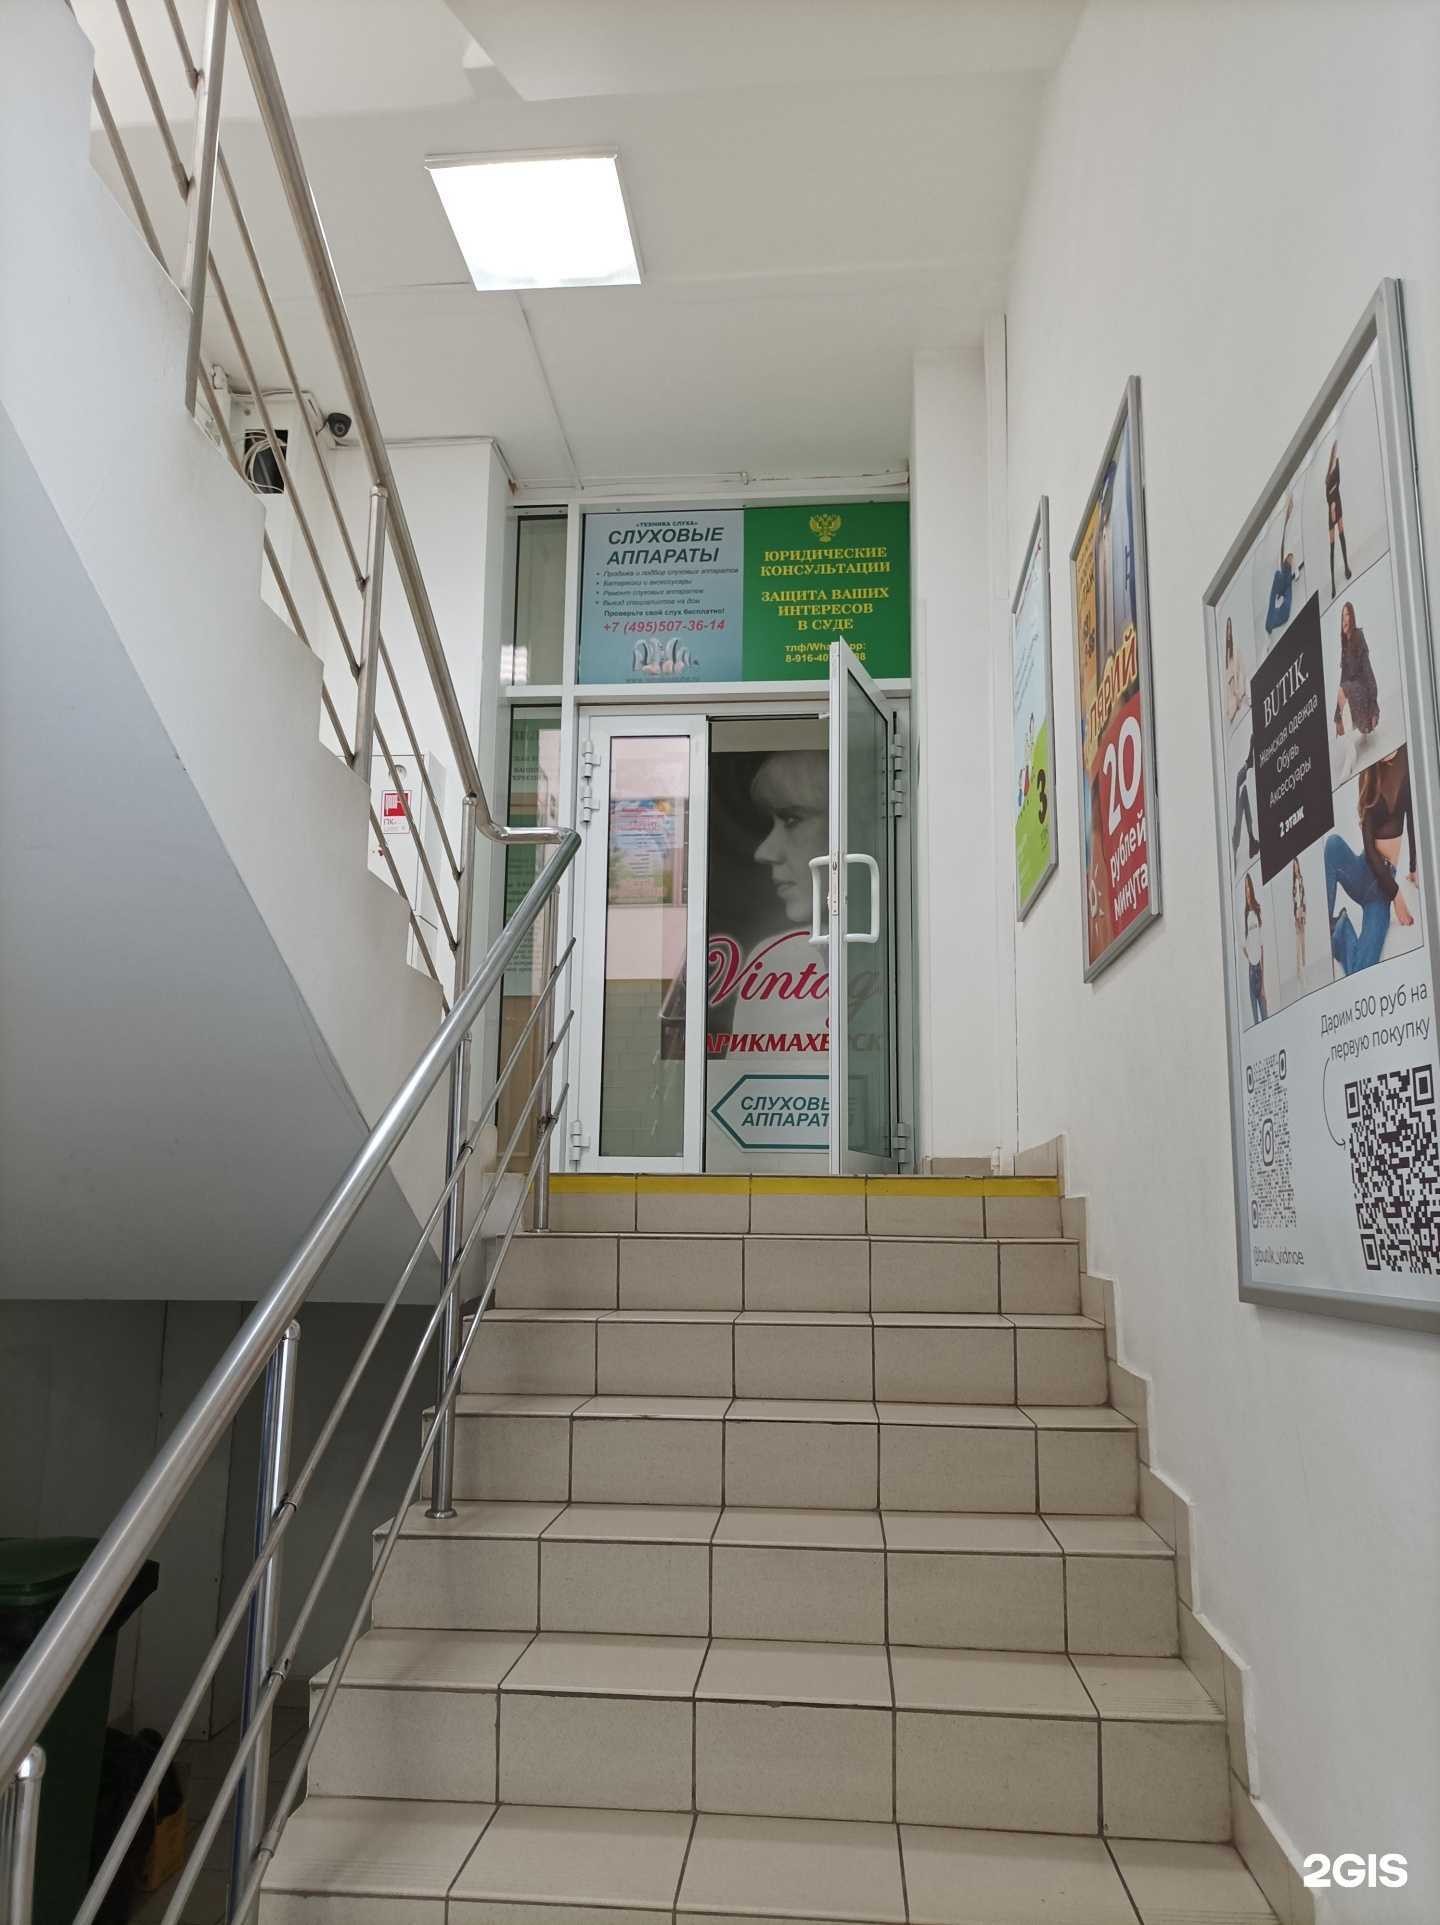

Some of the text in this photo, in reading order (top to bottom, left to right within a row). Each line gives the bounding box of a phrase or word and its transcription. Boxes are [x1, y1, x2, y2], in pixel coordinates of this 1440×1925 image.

[608, 527, 725, 545] СЛУХОВЫЕ
[606, 547, 720, 566] АППАРАТЫ
[760, 561, 891, 577] КОНСУЛЬТАЦИИ
[764, 546, 888, 562] ЮРИДИЧЕСКИЕ
[761, 587, 889, 602] ЗАЩИТА ВАШИХ
[778, 603, 873, 616] ИНТЕРЕСОВ
[603, 619, 726, 635] +7 (495)507-36-14
[798, 618, 854, 631] В СУДЕ
[1263, 652, 1309, 728] BUTIK.
[1259, 693, 1319, 768] Женская одежда
[1276, 744, 1300, 774] Обувь
[1102, 716, 1142, 836] 20
[1269, 757, 1312, 808] Аксессуары
[1279, 806, 1305, 838] 2 этаж
[1110, 812, 1147, 887] рублей
[1114, 864, 1150, 921] минута
[1320, 983, 1428, 1038] Дарим 500 руб на
[1330, 1016, 1430, 1062] первую покупку
